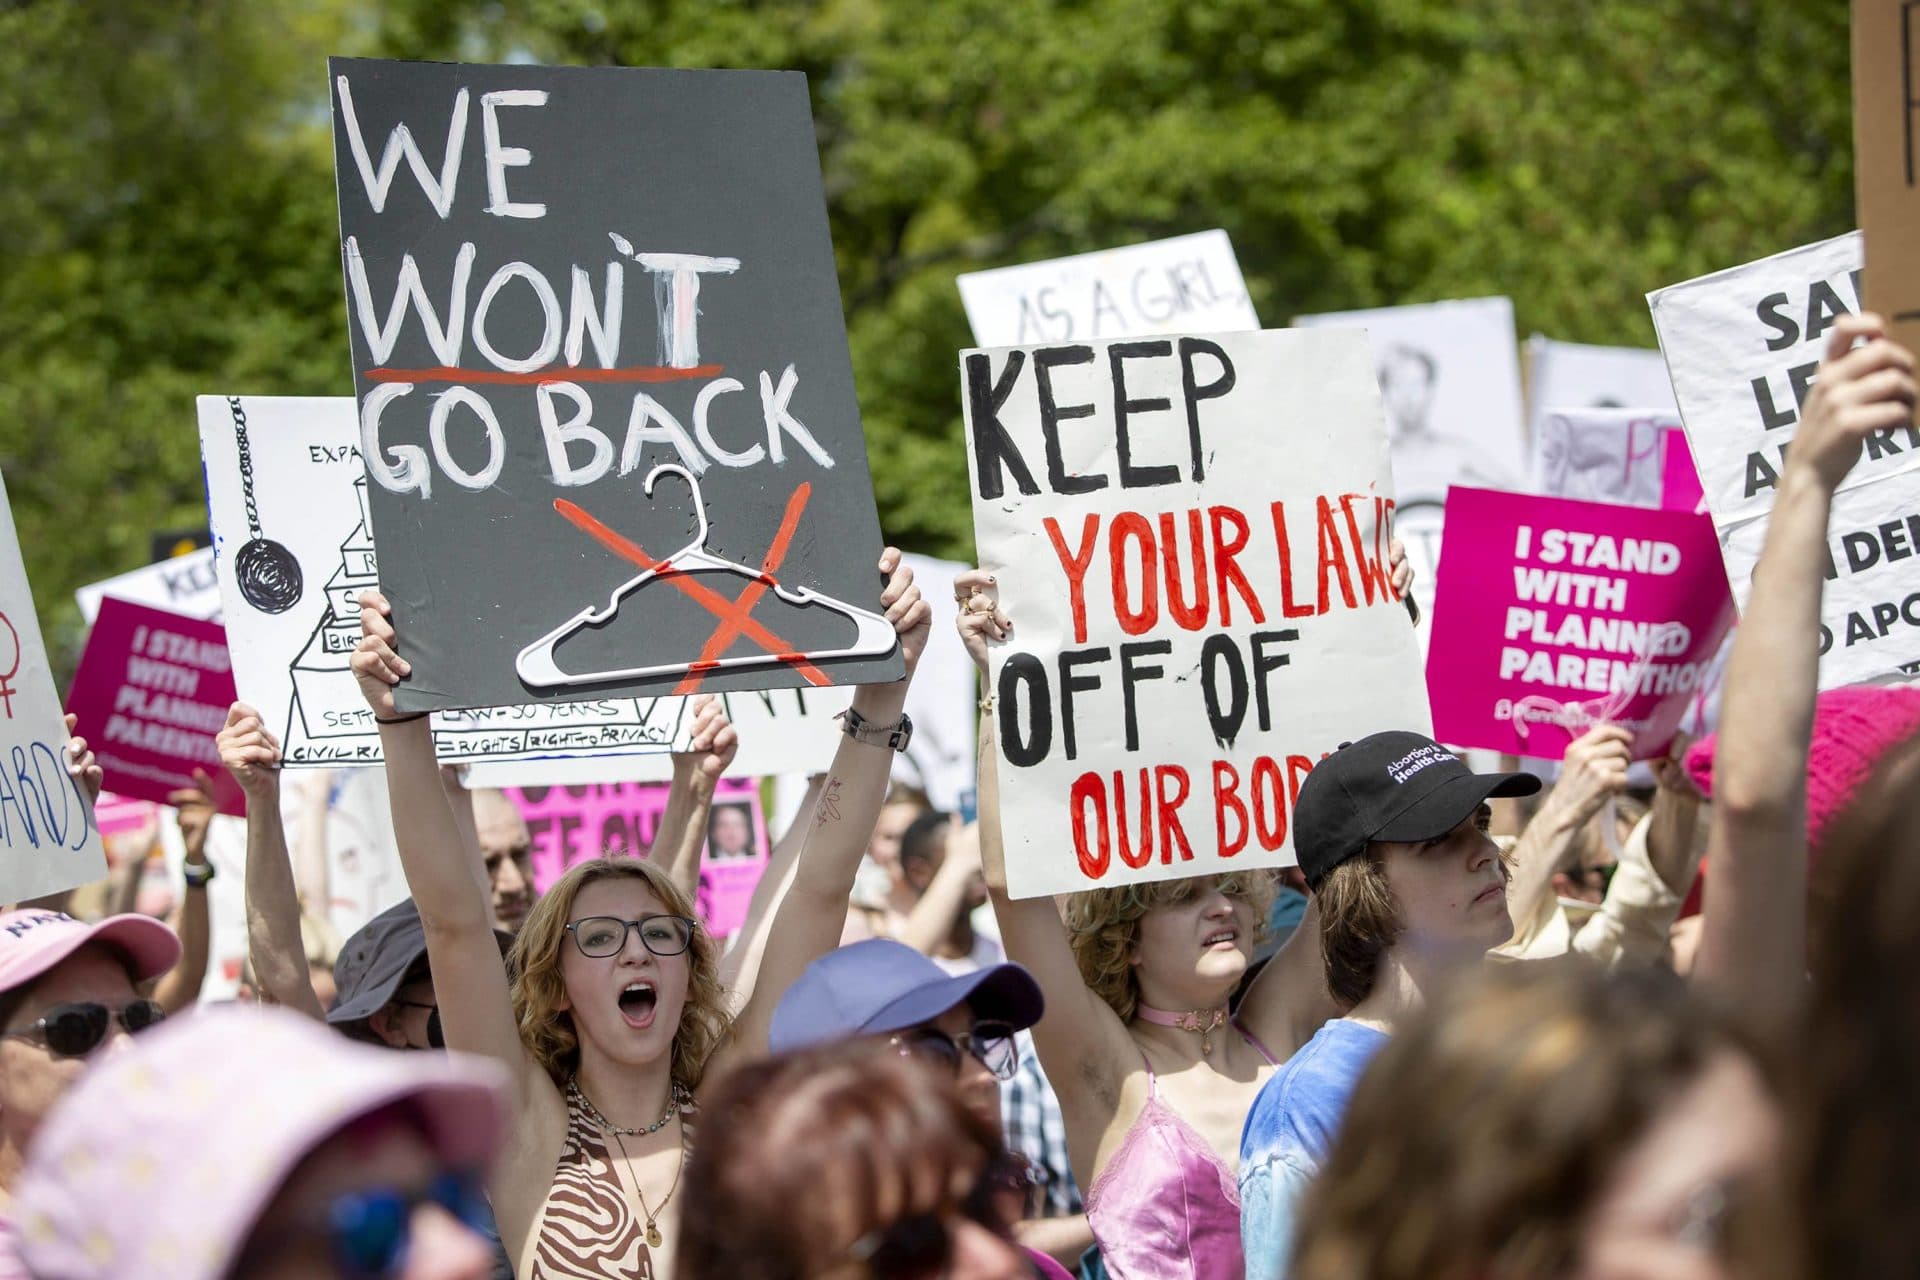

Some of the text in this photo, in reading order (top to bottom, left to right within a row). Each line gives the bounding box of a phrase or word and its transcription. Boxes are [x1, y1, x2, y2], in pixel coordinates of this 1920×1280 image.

[338, 74, 549, 219] WE
[346, 231, 742, 375] WON'T
[1756, 267, 1865, 352] SA
[360, 363, 837, 500] GO BACK
[966, 336, 1237, 500] KEEP
[1043, 505, 1265, 644] YOUR
[1512, 565, 1629, 612] WITH
[1514, 524, 1682, 576] I STAND
[1504, 605, 1692, 657] PLANNED
[1000, 628, 1300, 768] OFF OF
[1386, 744, 1433, 777] Abortion
[1394, 756, 1436, 784] Health
[1070, 764, 1194, 880] OUR
